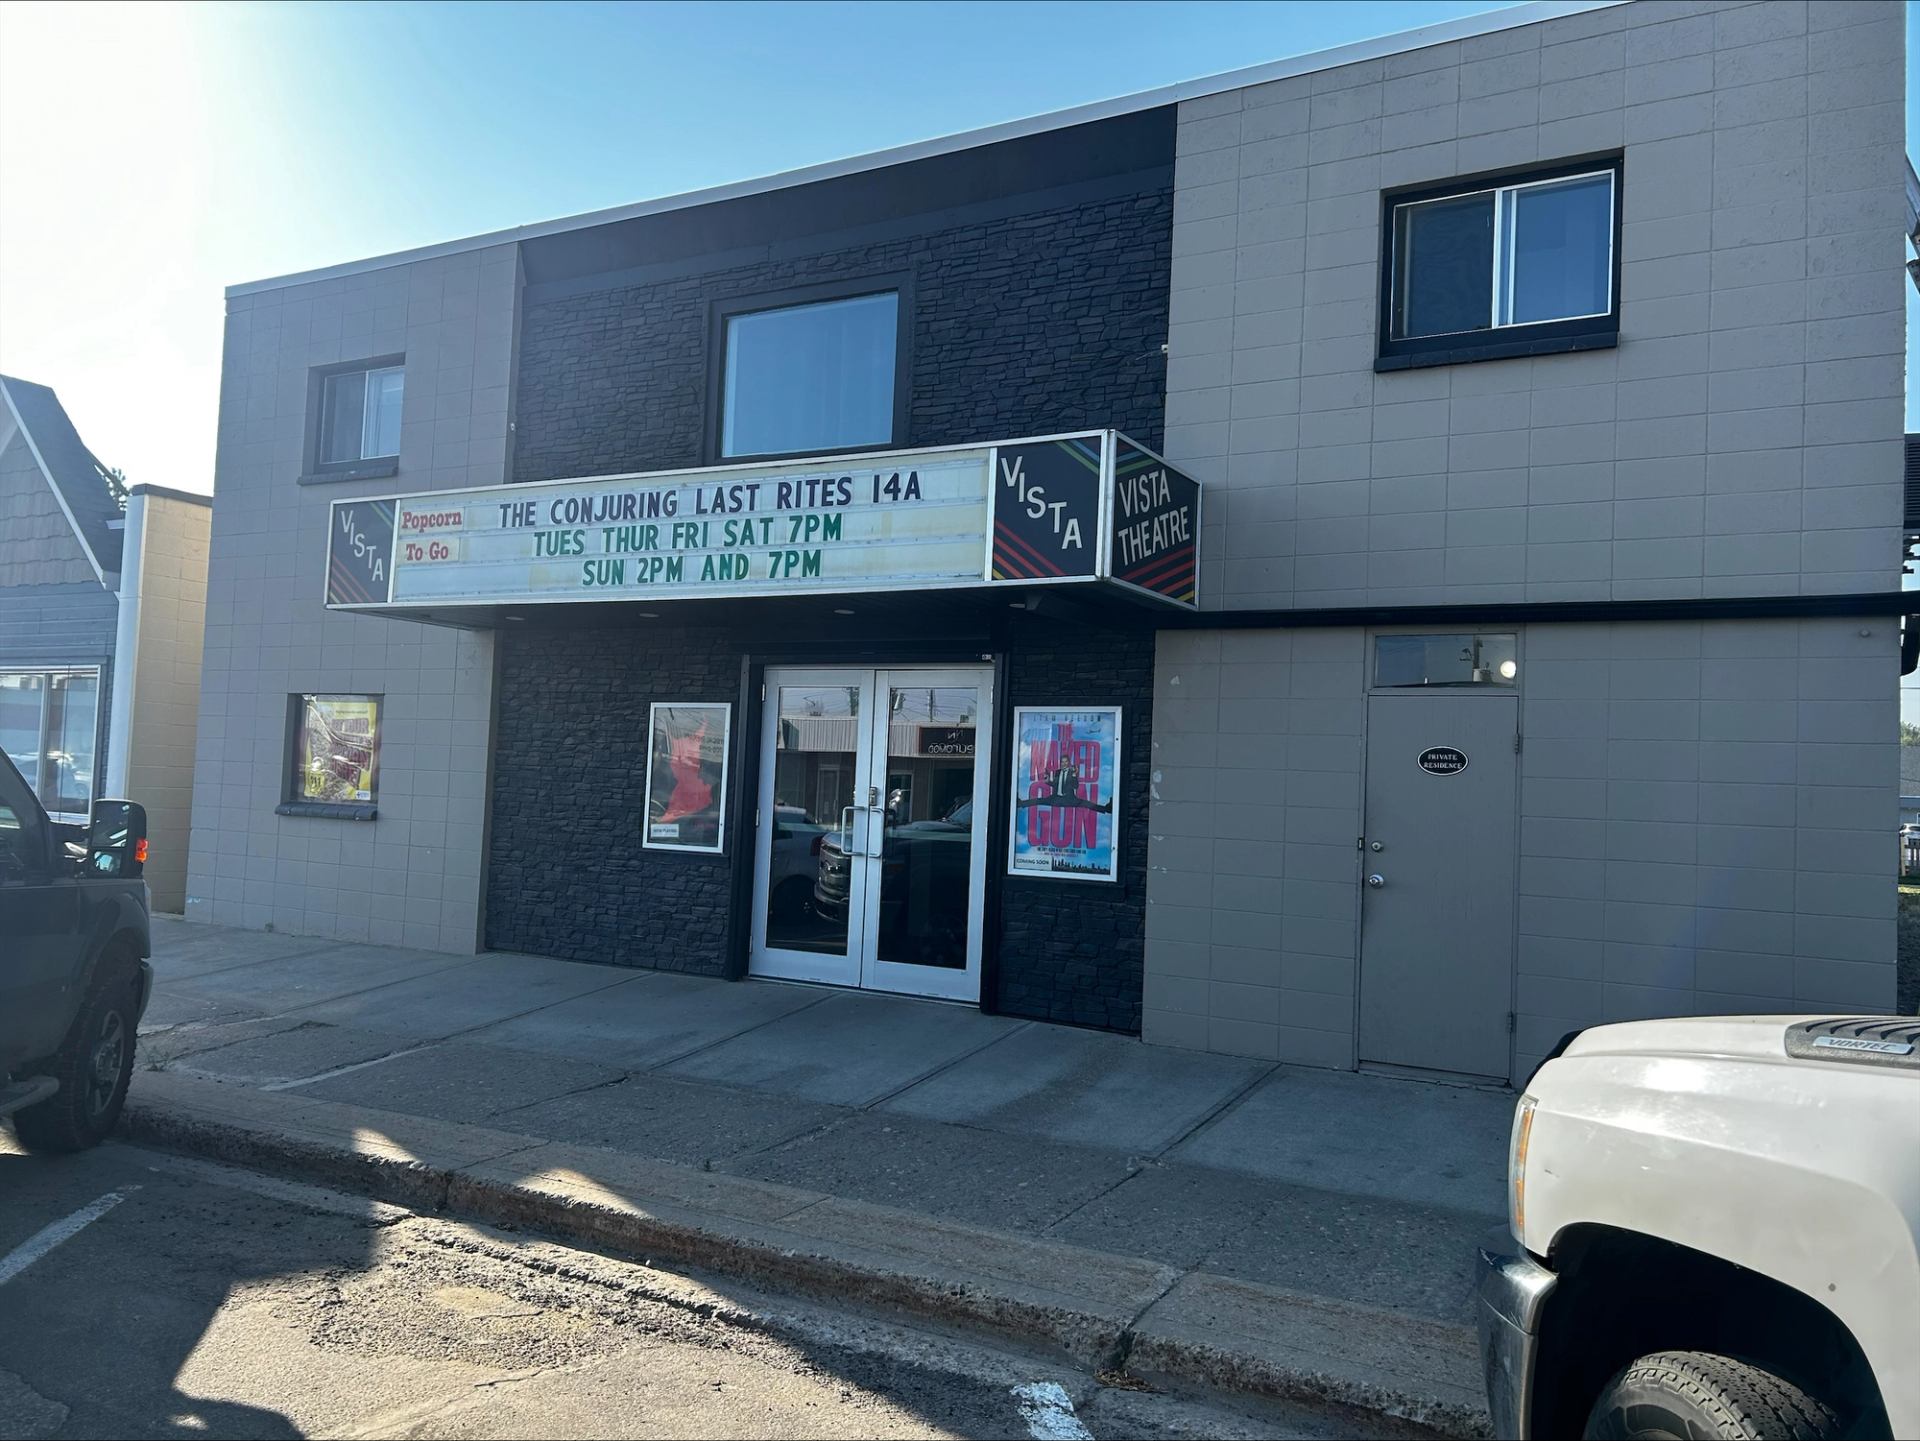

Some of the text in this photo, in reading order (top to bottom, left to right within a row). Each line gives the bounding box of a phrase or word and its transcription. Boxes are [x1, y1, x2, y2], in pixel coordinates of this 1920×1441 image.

[499, 471, 921, 528] THE CONJURING LAST RITES 14A
[1000, 456, 1083, 549] VISTA
[1118, 469, 1171, 518] VISTA
[341, 510, 383, 581] VISTA
[401, 511, 463, 533] Popcorn
[534, 512, 842, 557] TUES THUR FRI SAT 7PM
[1118, 505, 1190, 566] THEATRE
[405, 541, 449, 561] To Go
[582, 549, 821, 586] SUN 2PM AND 7PM
[1029, 739, 1101, 783] NAKED
[1027, 782, 1098, 849] GUN
[1830, 1039, 1897, 1051] VORTEC
